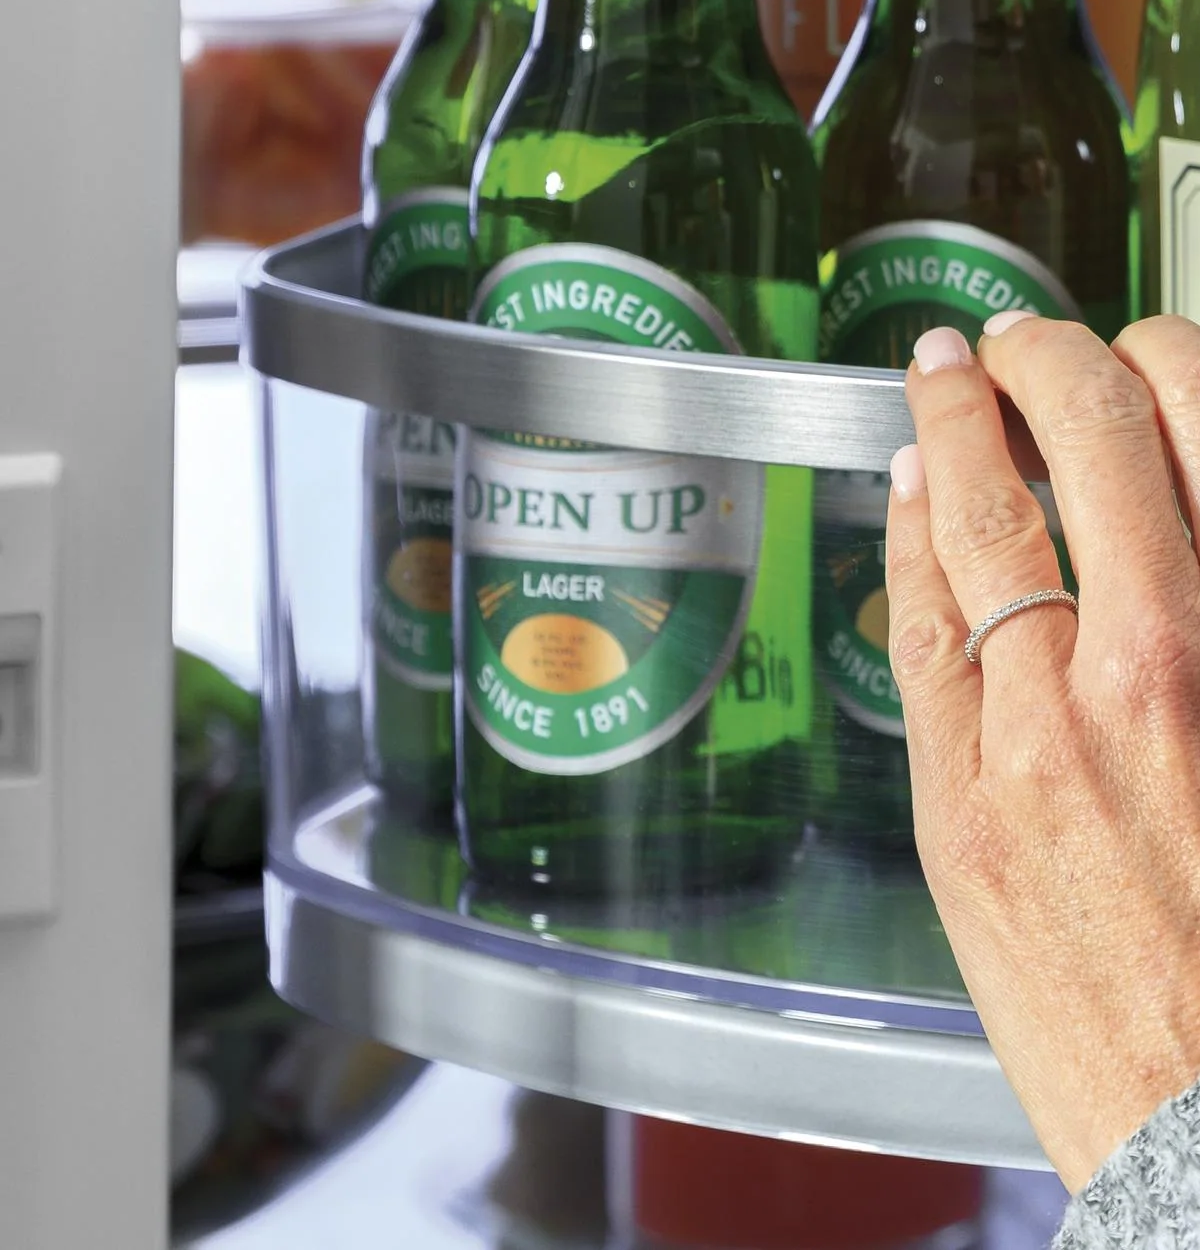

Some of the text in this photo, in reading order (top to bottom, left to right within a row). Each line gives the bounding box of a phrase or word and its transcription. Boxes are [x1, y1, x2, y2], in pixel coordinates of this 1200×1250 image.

[531, 279, 701, 352] INGREDIE
[463, 471, 707, 535] OPEN UP
[522, 571, 606, 602] LAGER
[476, 663, 650, 739] SINCE 1891
